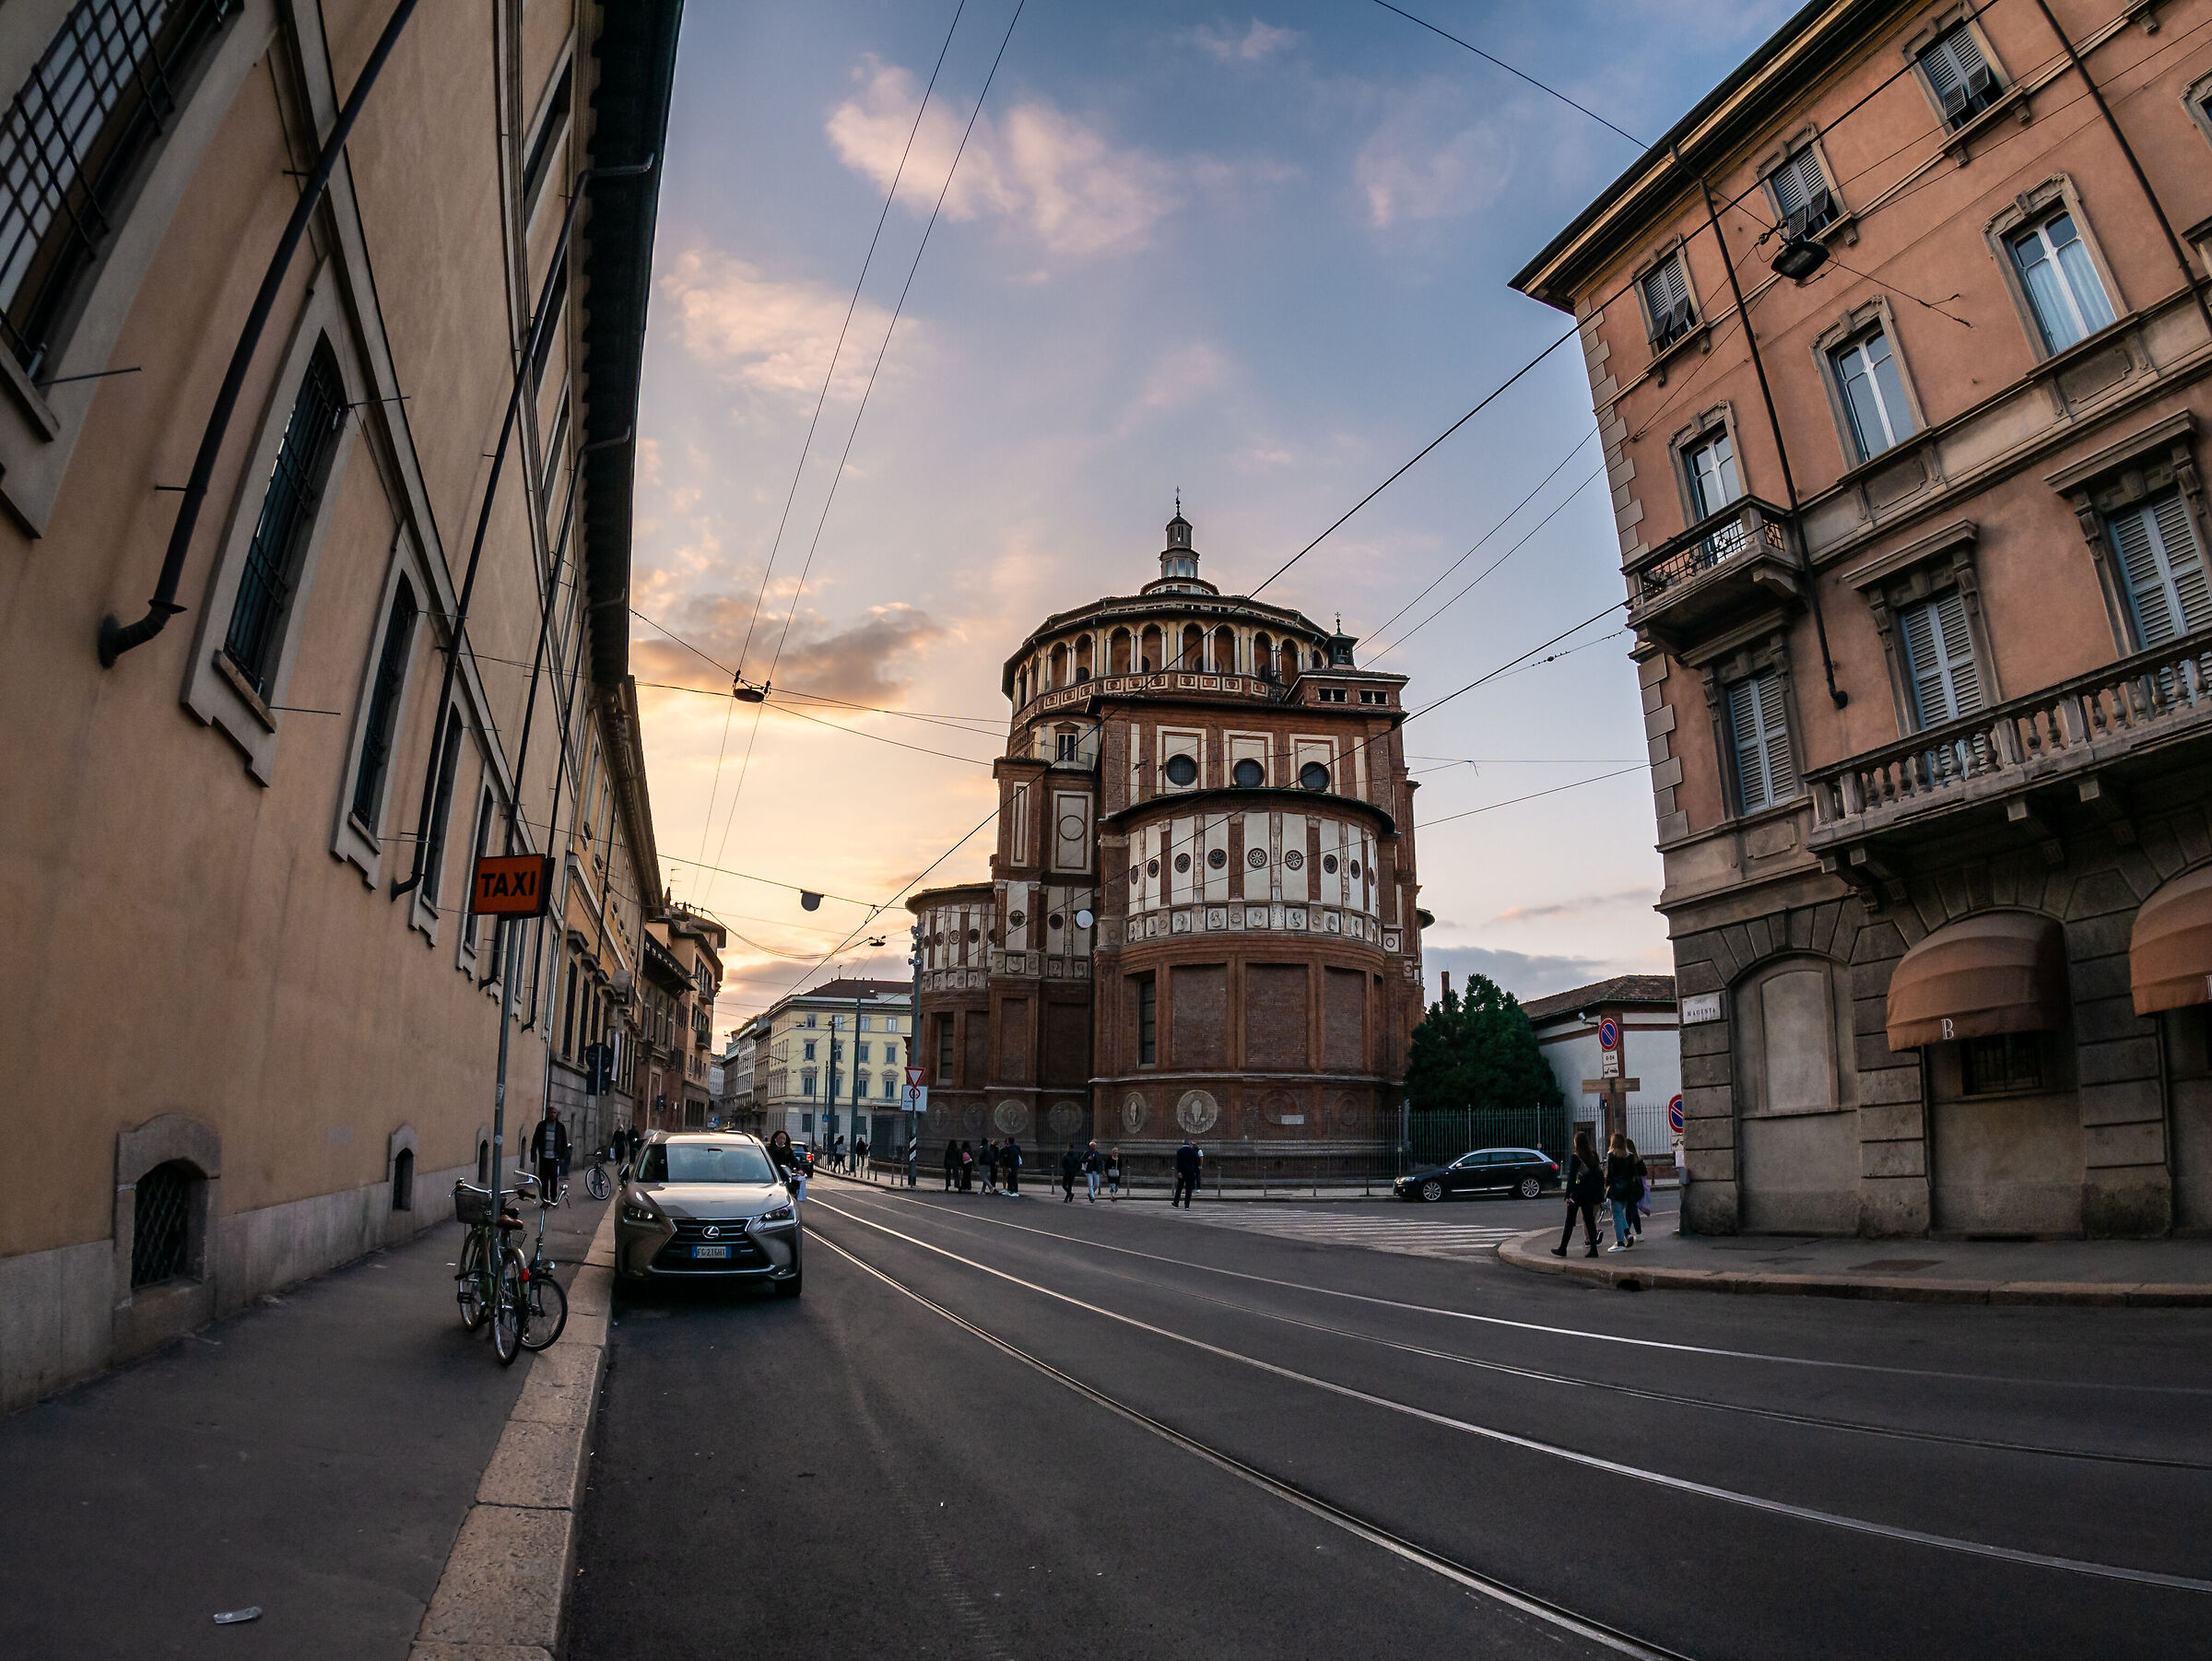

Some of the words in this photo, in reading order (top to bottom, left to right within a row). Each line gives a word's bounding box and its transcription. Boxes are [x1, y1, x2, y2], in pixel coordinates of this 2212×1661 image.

[480, 871, 536, 898] TAXI
[1687, 1007, 1716, 1017] MAGENTA
[1940, 1018, 1955, 1040] B
